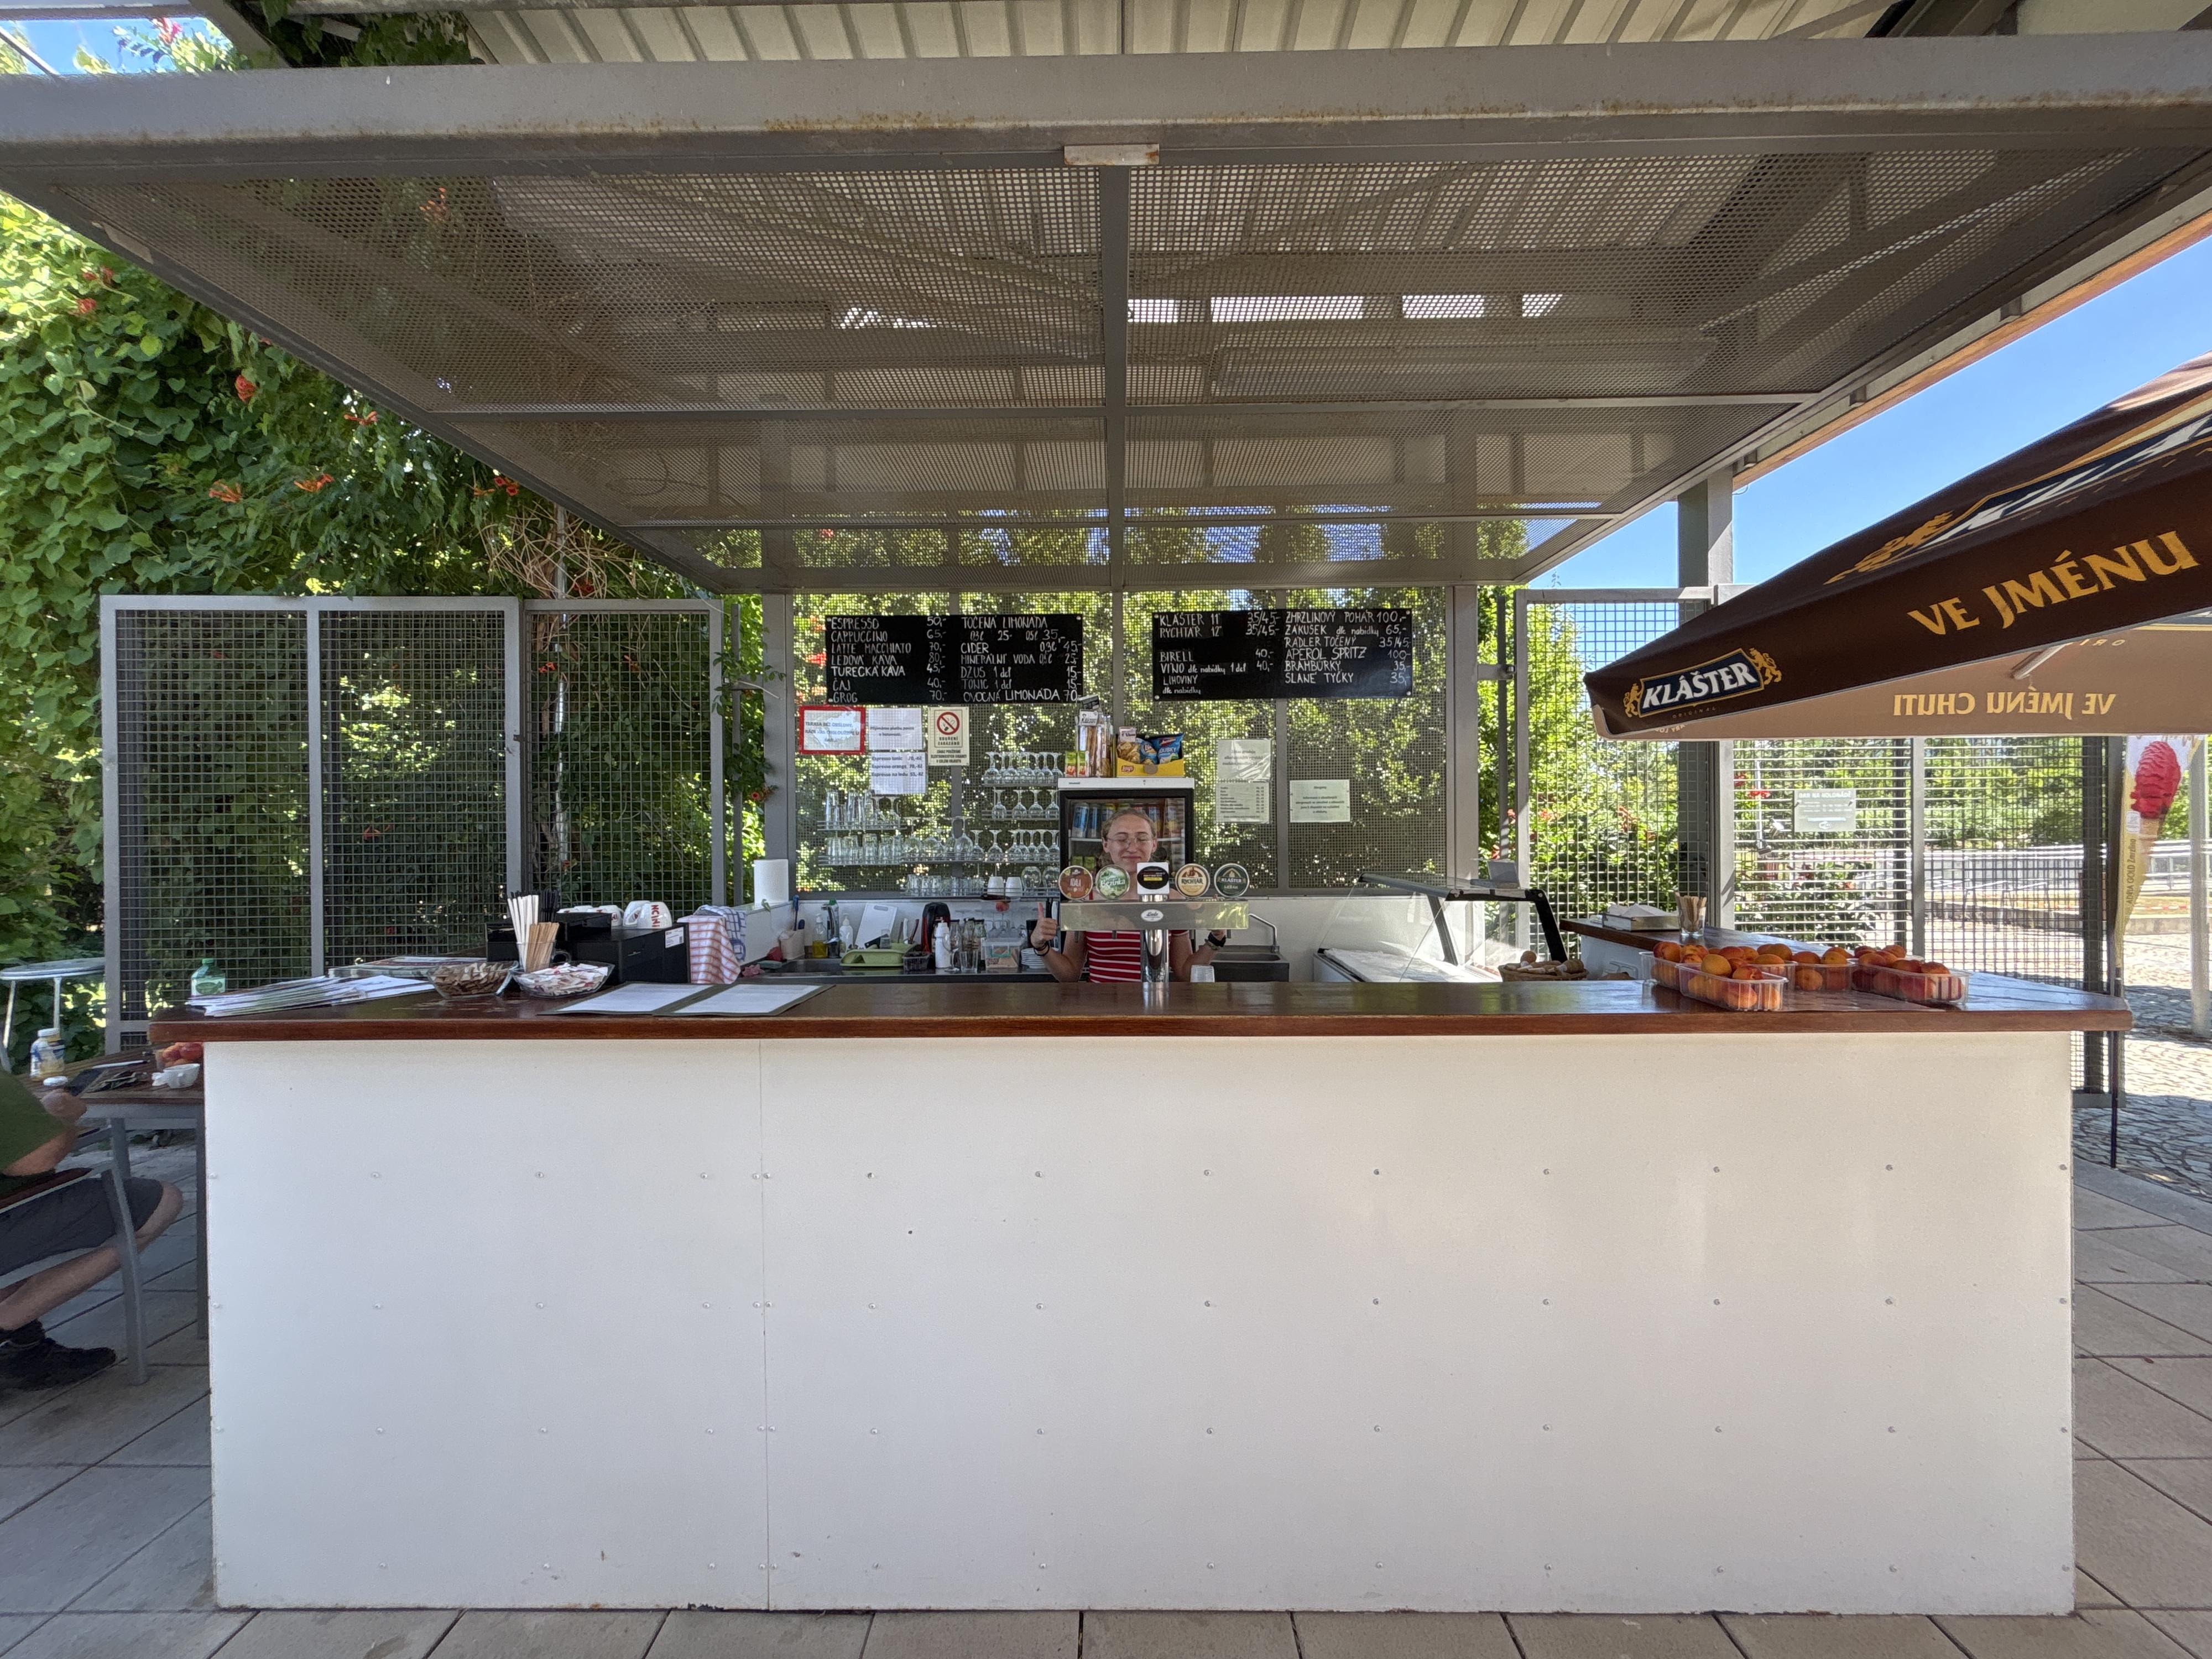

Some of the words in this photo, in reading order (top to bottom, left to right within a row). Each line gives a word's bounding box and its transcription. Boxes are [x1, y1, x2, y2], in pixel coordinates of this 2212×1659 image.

[1907, 597, 1980, 635] VE
[1982, 531, 2200, 629] JMÉNU
[831, 617, 879, 630] ESPRESSO
[926, 616, 947, 627] 50,-
[1159, 612, 1204, 627] KLÁŠTER
[1285, 610, 1335, 624] ZMRZLINOVÝ
[1344, 610, 1374, 623] POHÁR
[1376, 611, 1406, 623] 100,-
[831, 630, 888, 643] CAPPUCCINO
[926, 629, 947, 639] 65,-
[1285, 624, 1327, 635] ZÁKUSEK
[1336, 625, 1346, 635] dle
[1386, 624, 1406, 635] 65,-
[1324, 634, 1357, 647] TOČENÝ
[832, 643, 856, 654] LATTE
[864, 642, 911, 654] MACCHIATO
[929, 642, 946, 652] 70,-
[961, 642, 989, 654] CIDER
[1286, 648, 1327, 661] APEROL
[1331, 646, 1367, 660] SPRITZ
[831, 654, 864, 666] LEDOVÁ
[872, 653, 898, 665] KÁVA
[928, 652, 946, 665] 80,-
[961, 653, 1007, 665] MINERÁLNÍ
[1013, 654, 1035, 664] VODA
[1159, 651, 1193, 662] BIRELL
[1255, 649, 1274, 659] 40,-
[831, 665, 879, 677] TURECKÁ
[881, 664, 905, 677] KÁVA
[926, 663, 946, 674] 45,-
[994, 666, 998, 677] 1
[1188, 664, 1198, 673] dle
[1230, 662, 1234, 672] 1
[1256, 660, 1273, 672] 40,-
[1394, 660, 1410, 672] 35,-
[833, 677, 851, 691] ČAJ
[927, 677, 946, 688] 40,-
[961, 679, 989, 690] TONIC
[995, 679, 998, 689] 1
[1163, 675, 1198, 686] LIHOVINY
[1285, 672, 1317, 684] SLANÉ
[1323, 671, 1354, 684] TYČKY
[1390, 671, 1410, 686] 35,-
[1642, 662, 1756, 709] KLÁŠTER
[833, 691, 858, 703] GROG
[929, 690, 947, 701] 70,-
[963, 689, 1000, 702] OVOCNÁ
[1005, 688, 1060, 701] LIMONÁDA
[1672, 707, 1717, 718] ORIGINAL
[2126, 864, 2135, 884] GOLD
